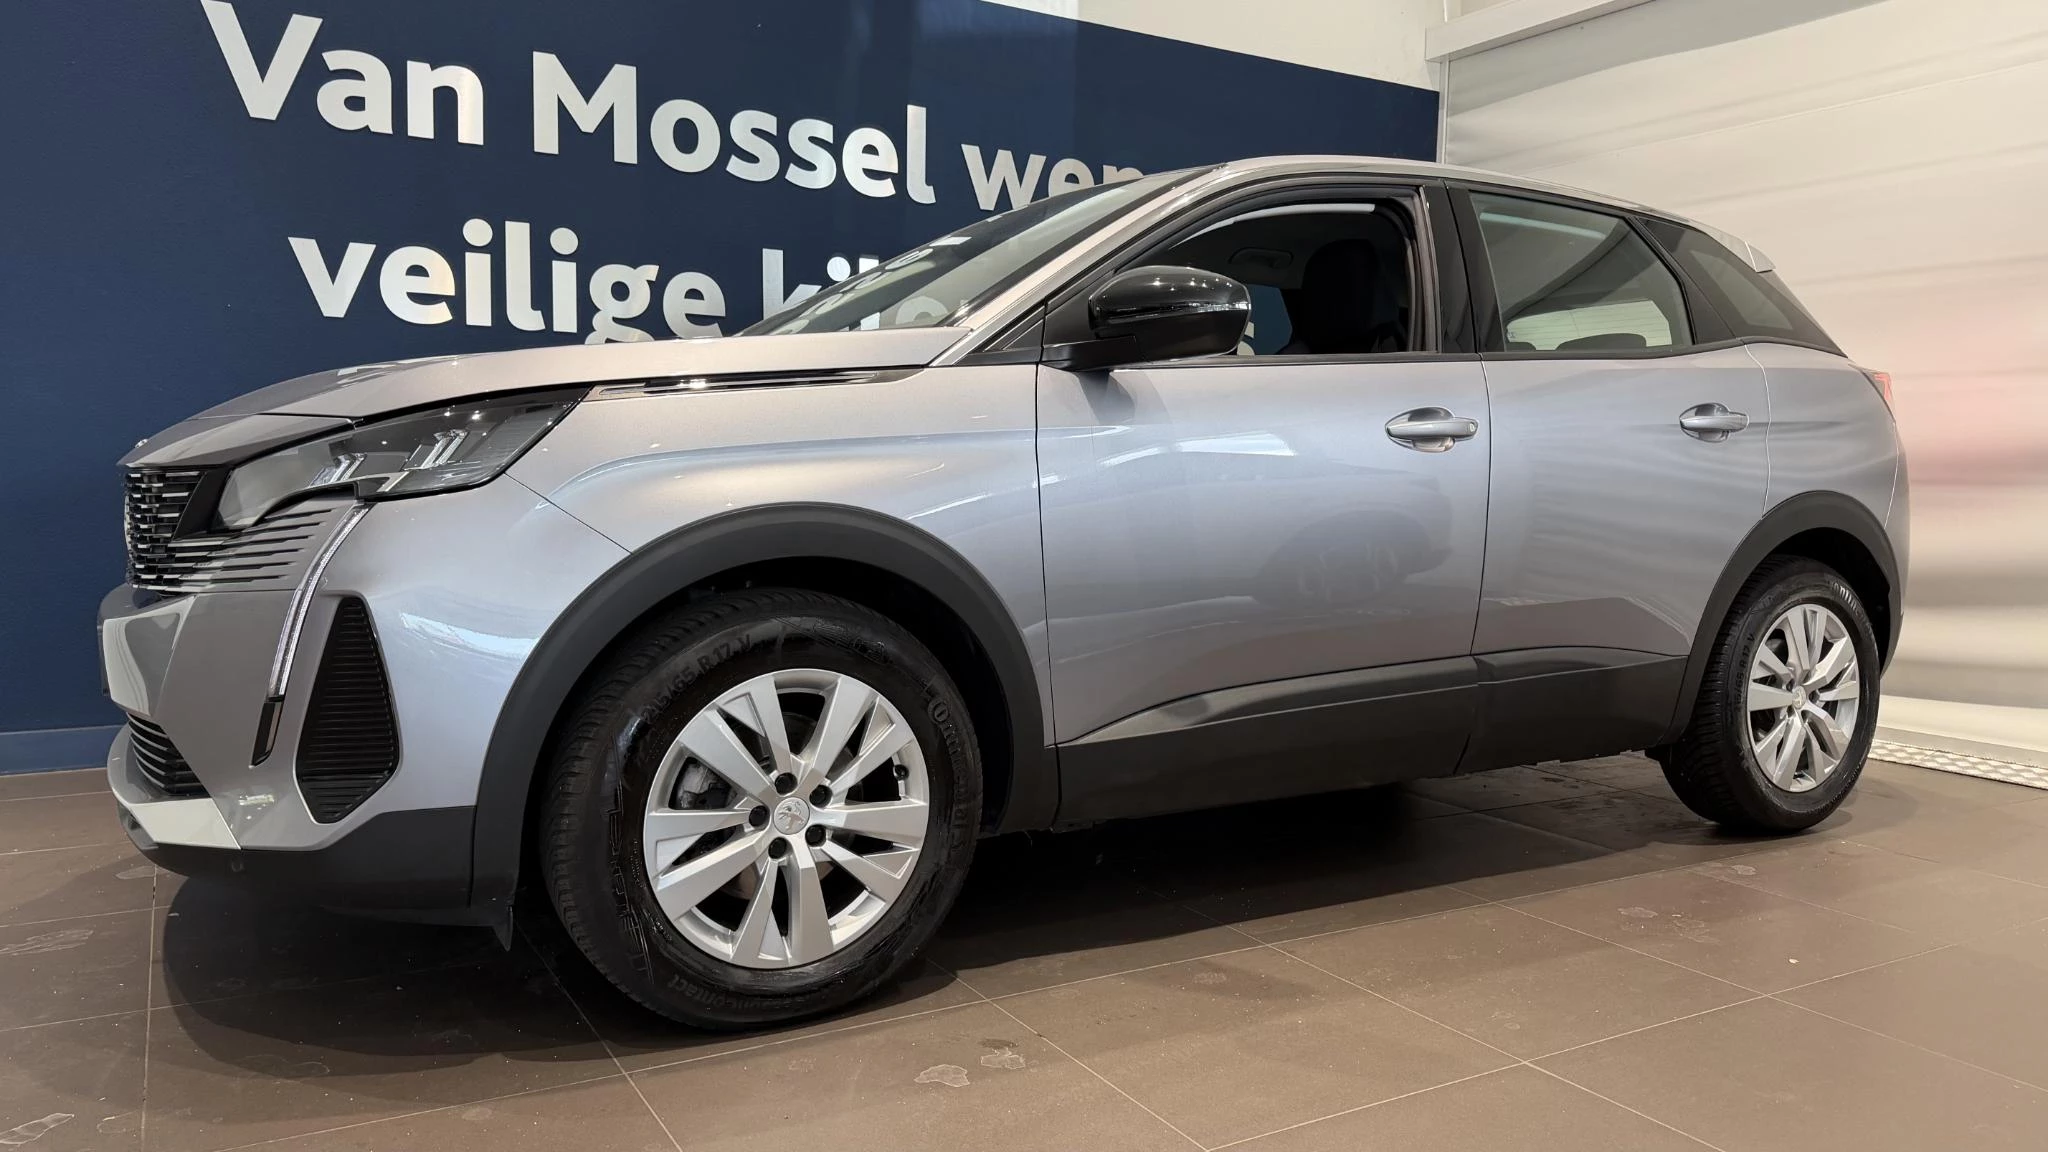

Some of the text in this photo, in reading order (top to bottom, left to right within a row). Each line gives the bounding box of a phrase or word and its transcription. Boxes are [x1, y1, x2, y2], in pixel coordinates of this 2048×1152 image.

[202, 0, 485, 146] Van
[532, 50, 936, 204] Mossel
[288, 218, 726, 345] veilige
